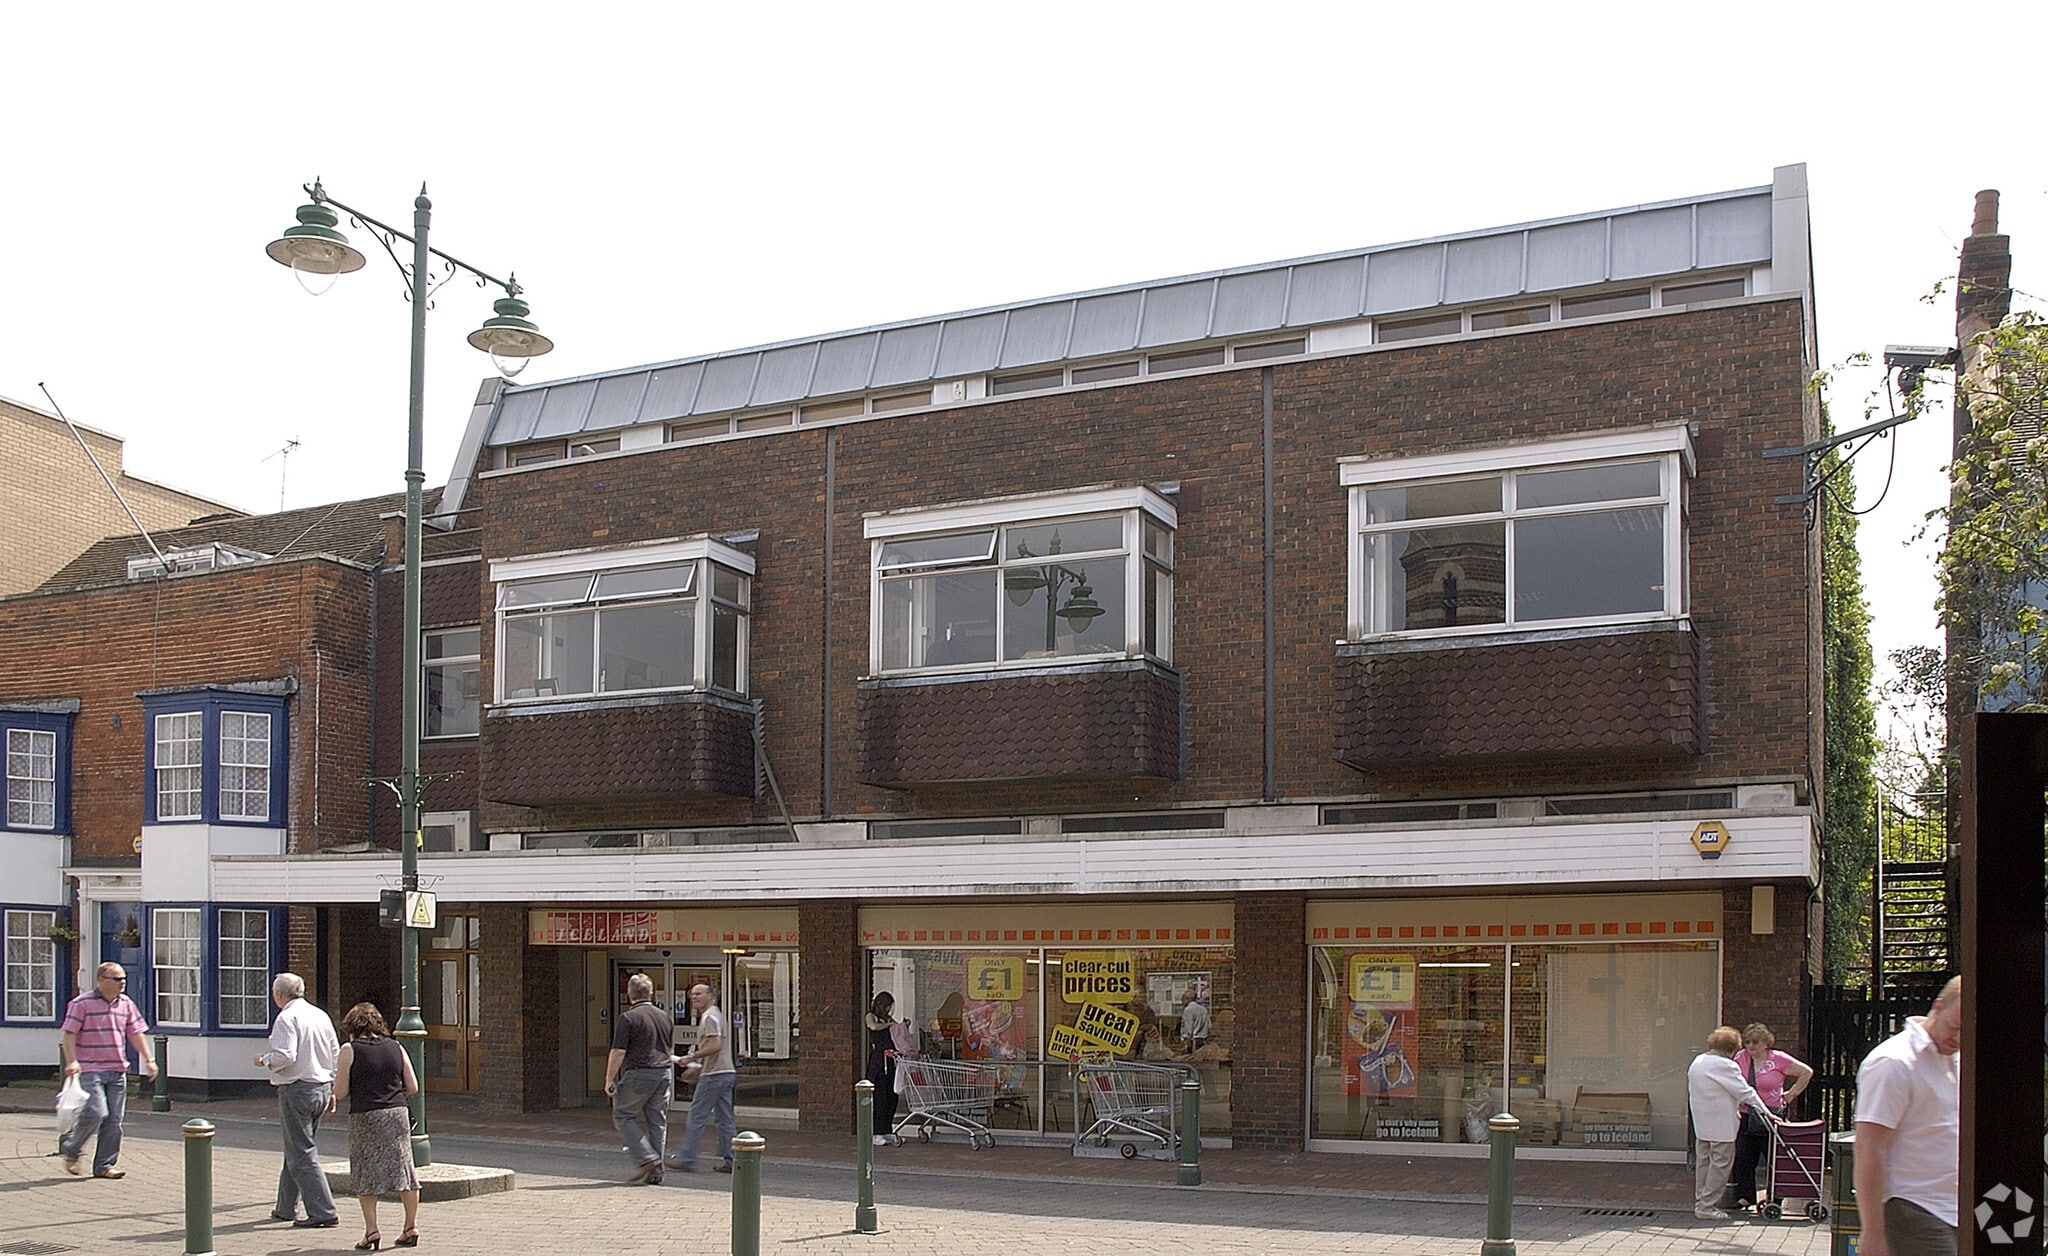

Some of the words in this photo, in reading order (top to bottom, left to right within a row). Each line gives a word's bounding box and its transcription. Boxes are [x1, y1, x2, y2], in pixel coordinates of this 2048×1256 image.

[1701, 832, 1719, 842] ADT
[555, 928, 649, 942] ICELAND
[1065, 960, 1131, 973] clear-cut
[977, 967, 1011, 990] £1
[1065, 974, 1131, 995] prices
[1360, 966, 1401, 991] £1
[1083, 1003, 1136, 1036] great
[1054, 1030, 1080, 1047] half
[1078, 1020, 1129, 1049] savings
[1376, 1127, 1389, 1138] go
[1390, 1127, 1401, 1138] to
[1401, 1126, 1439, 1138] Iceland
[1584, 1132, 1598, 1144] go
[1599, 1132, 1610, 1143] to
[1612, 1132, 1652, 1143] Iceland
